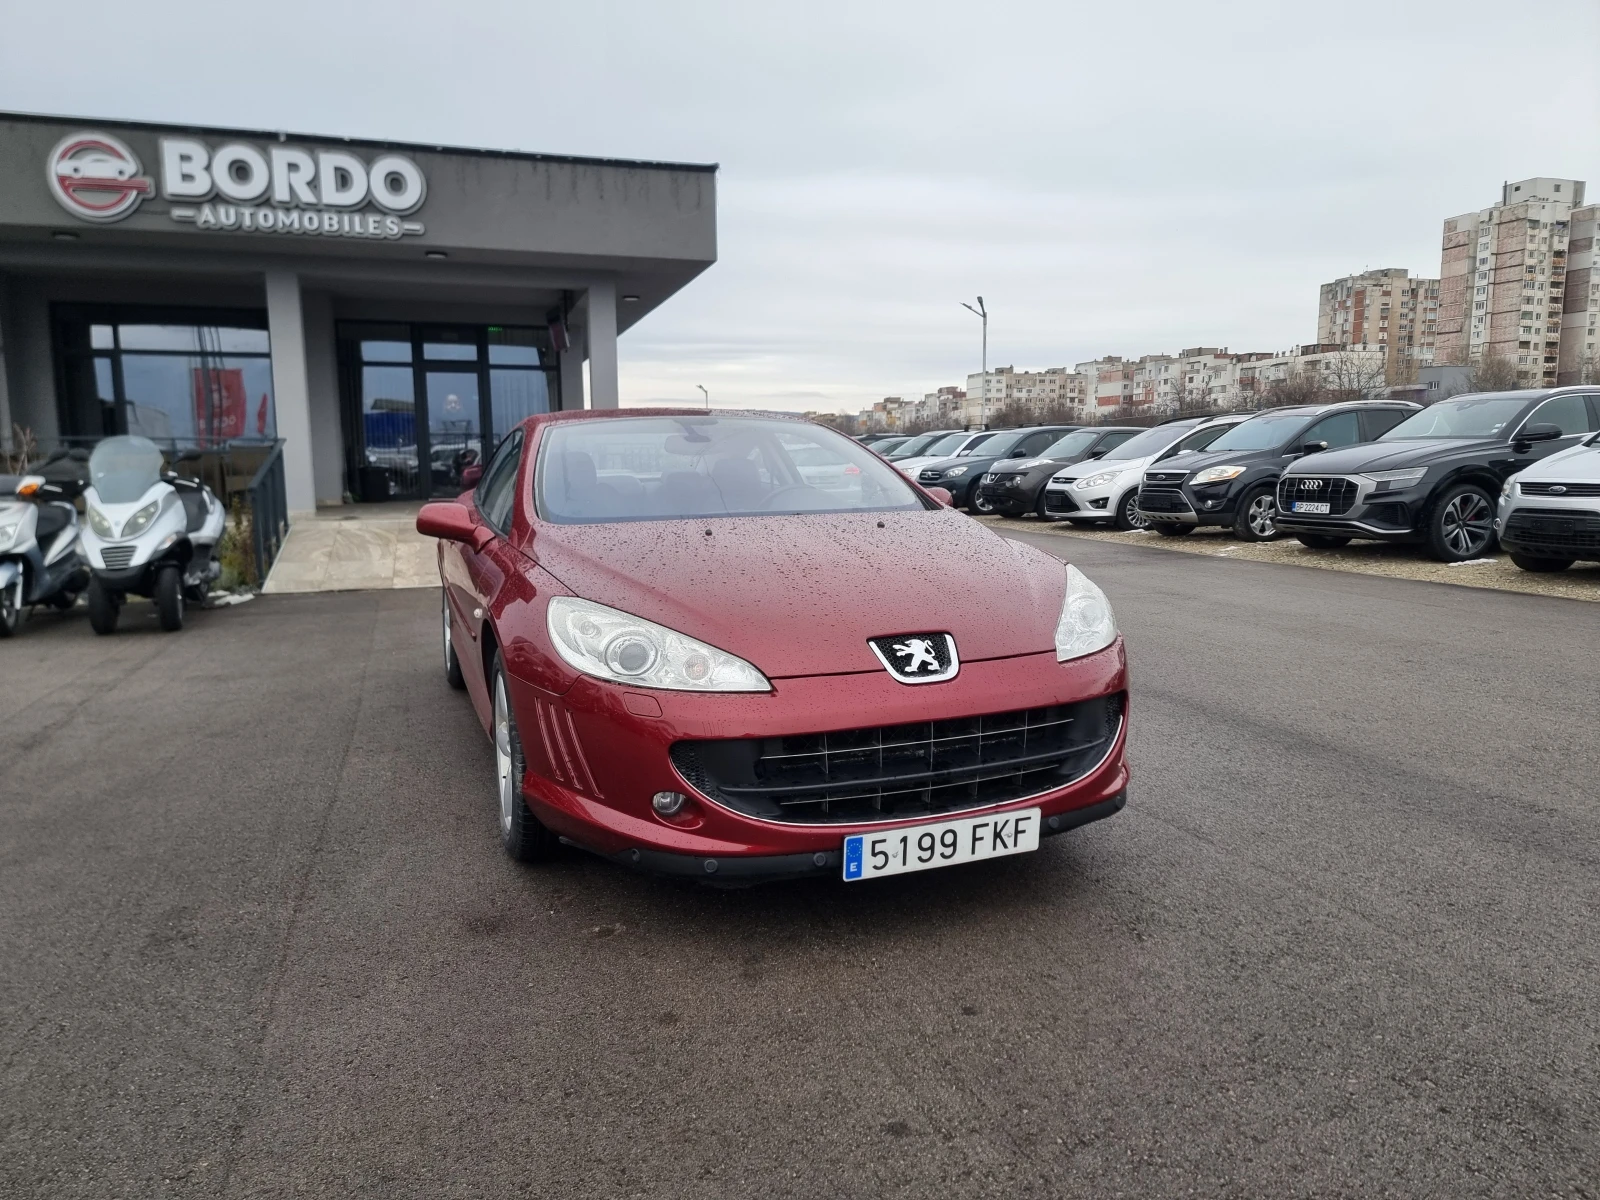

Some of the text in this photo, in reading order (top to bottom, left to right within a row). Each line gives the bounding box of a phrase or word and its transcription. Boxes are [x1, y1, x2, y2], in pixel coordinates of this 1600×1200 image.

[163, 139, 422, 210] BORDO
[200, 206, 400, 236] AUTOMOBILES
[1320, 504, 1329, 512] CT
[871, 816, 1032, 871] 5199 FKF
[850, 862, 858, 872] E
